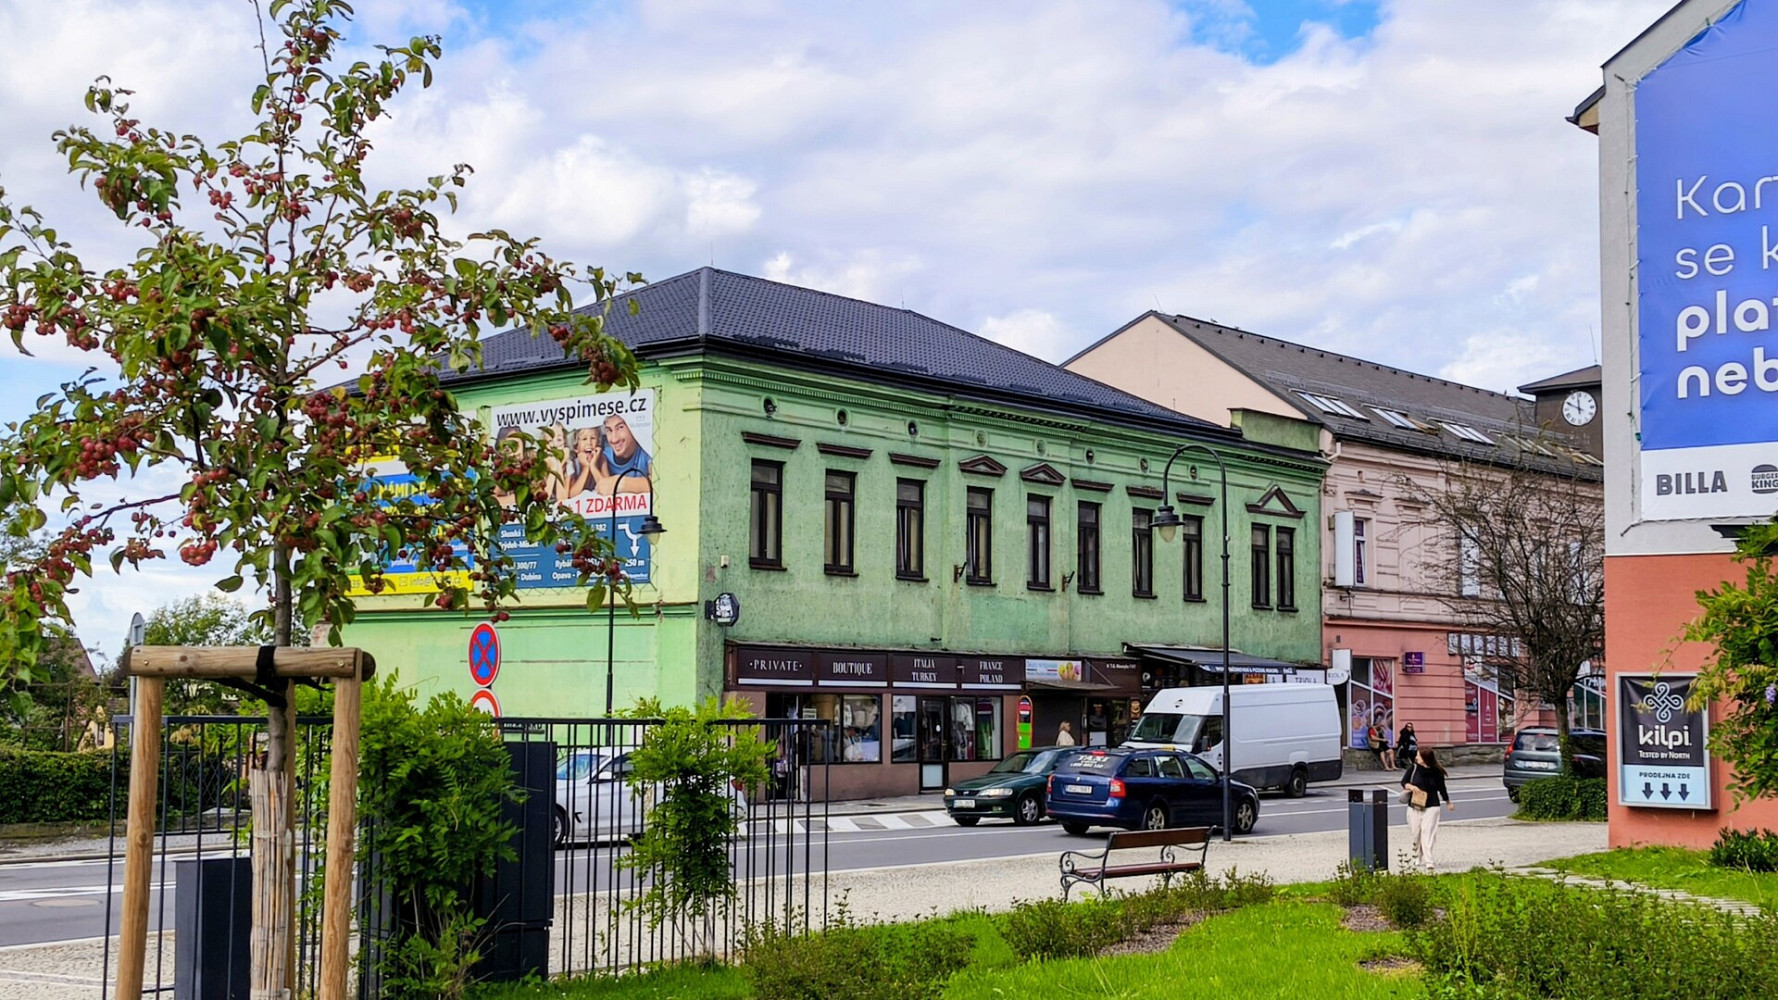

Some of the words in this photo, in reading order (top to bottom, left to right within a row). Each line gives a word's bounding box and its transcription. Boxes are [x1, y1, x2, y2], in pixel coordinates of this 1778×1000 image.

[1676, 174, 1778, 220] Kar
[1675, 243, 1735, 280] se
[1676, 289, 1778, 352] pla
[497, 397, 646, 426] www.vyspimese.cz
[1656, 470, 1728, 496] BILLA
[1751, 479, 1778, 489] KING
[586, 495, 648, 515] ZDARMA
[752, 659, 799, 671] PRIVATE
[832, 662, 873, 676] BOUTIQUE
[914, 658, 935, 668] ITALIA
[979, 661, 1003, 671] FRANCE
[912, 671, 937, 682] TURKEY
[979, 674, 1003, 684] POLAND
[1638, 724, 1691, 750] kilpi
[1639, 771, 1676, 779] PRODEJNA
